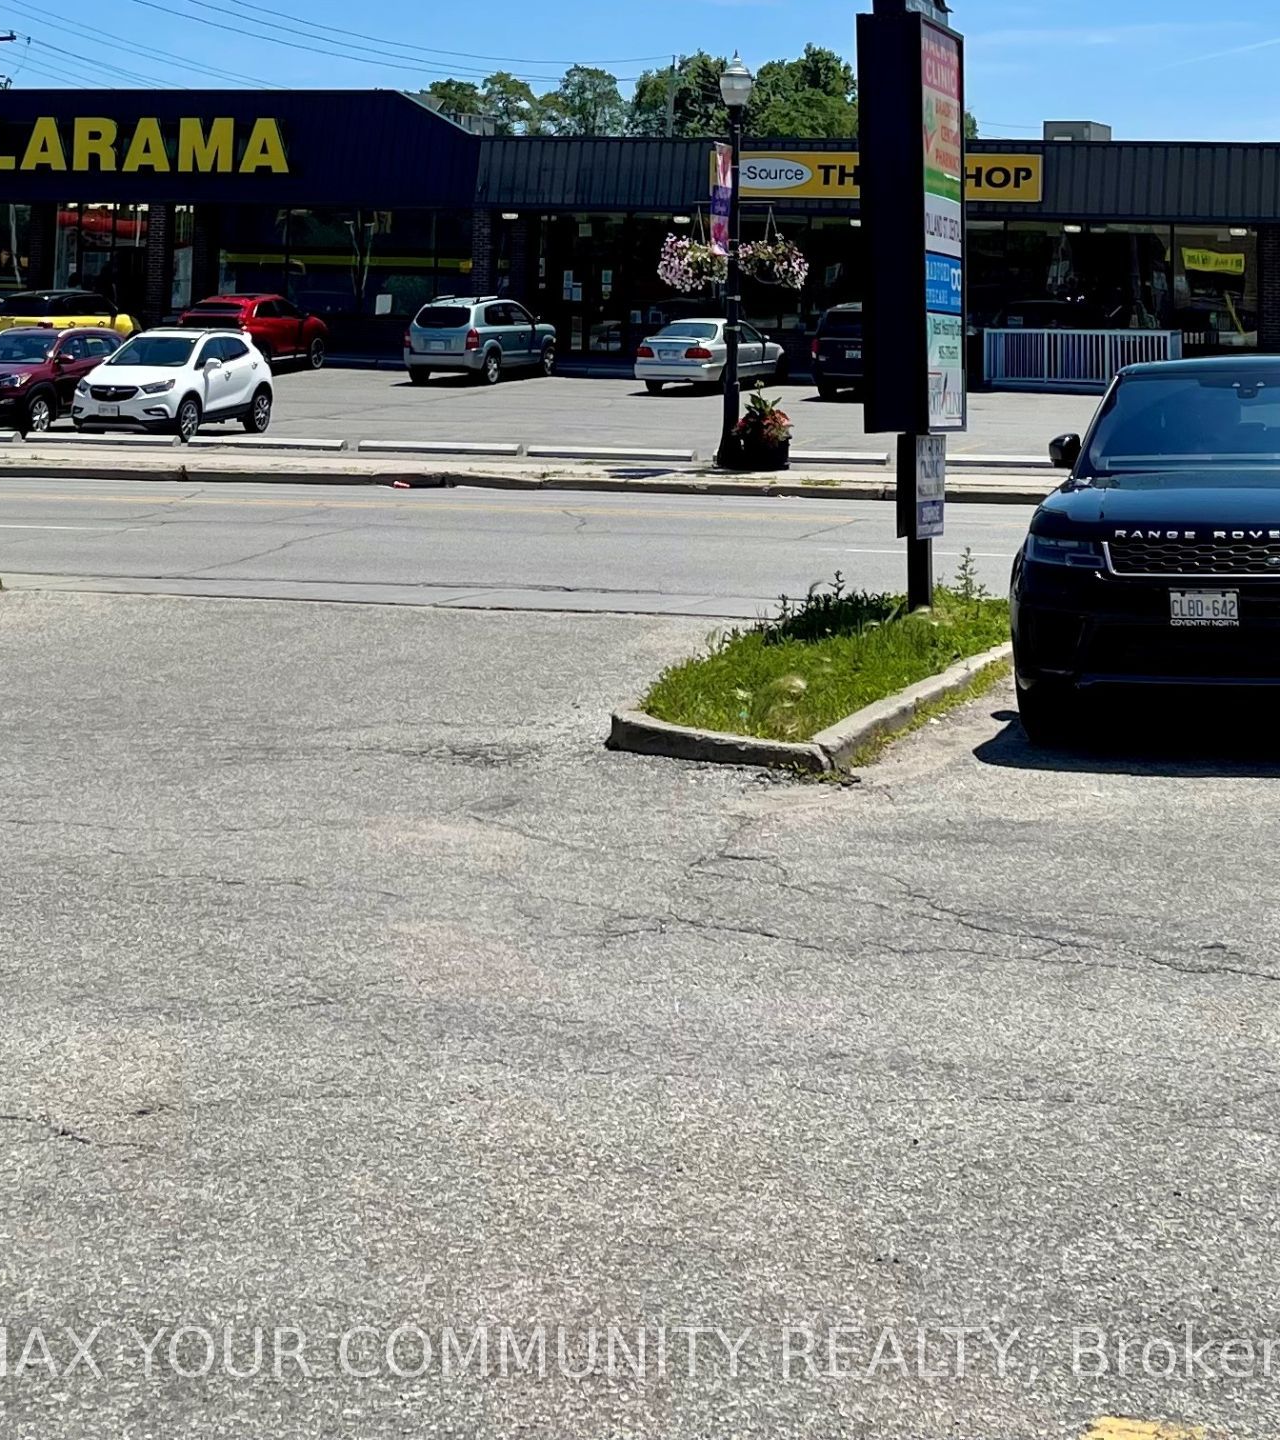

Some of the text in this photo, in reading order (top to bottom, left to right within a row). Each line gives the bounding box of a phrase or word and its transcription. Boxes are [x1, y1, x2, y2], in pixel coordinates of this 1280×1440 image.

[740, 165, 804, 181] -Source
[965, 166, 1032, 188] HOP
[1114, 530, 1196, 539] RANGE
[1172, 599, 1236, 618] CLBD 642
[1170, 619, 1239, 627] COVENTRY NORTH
